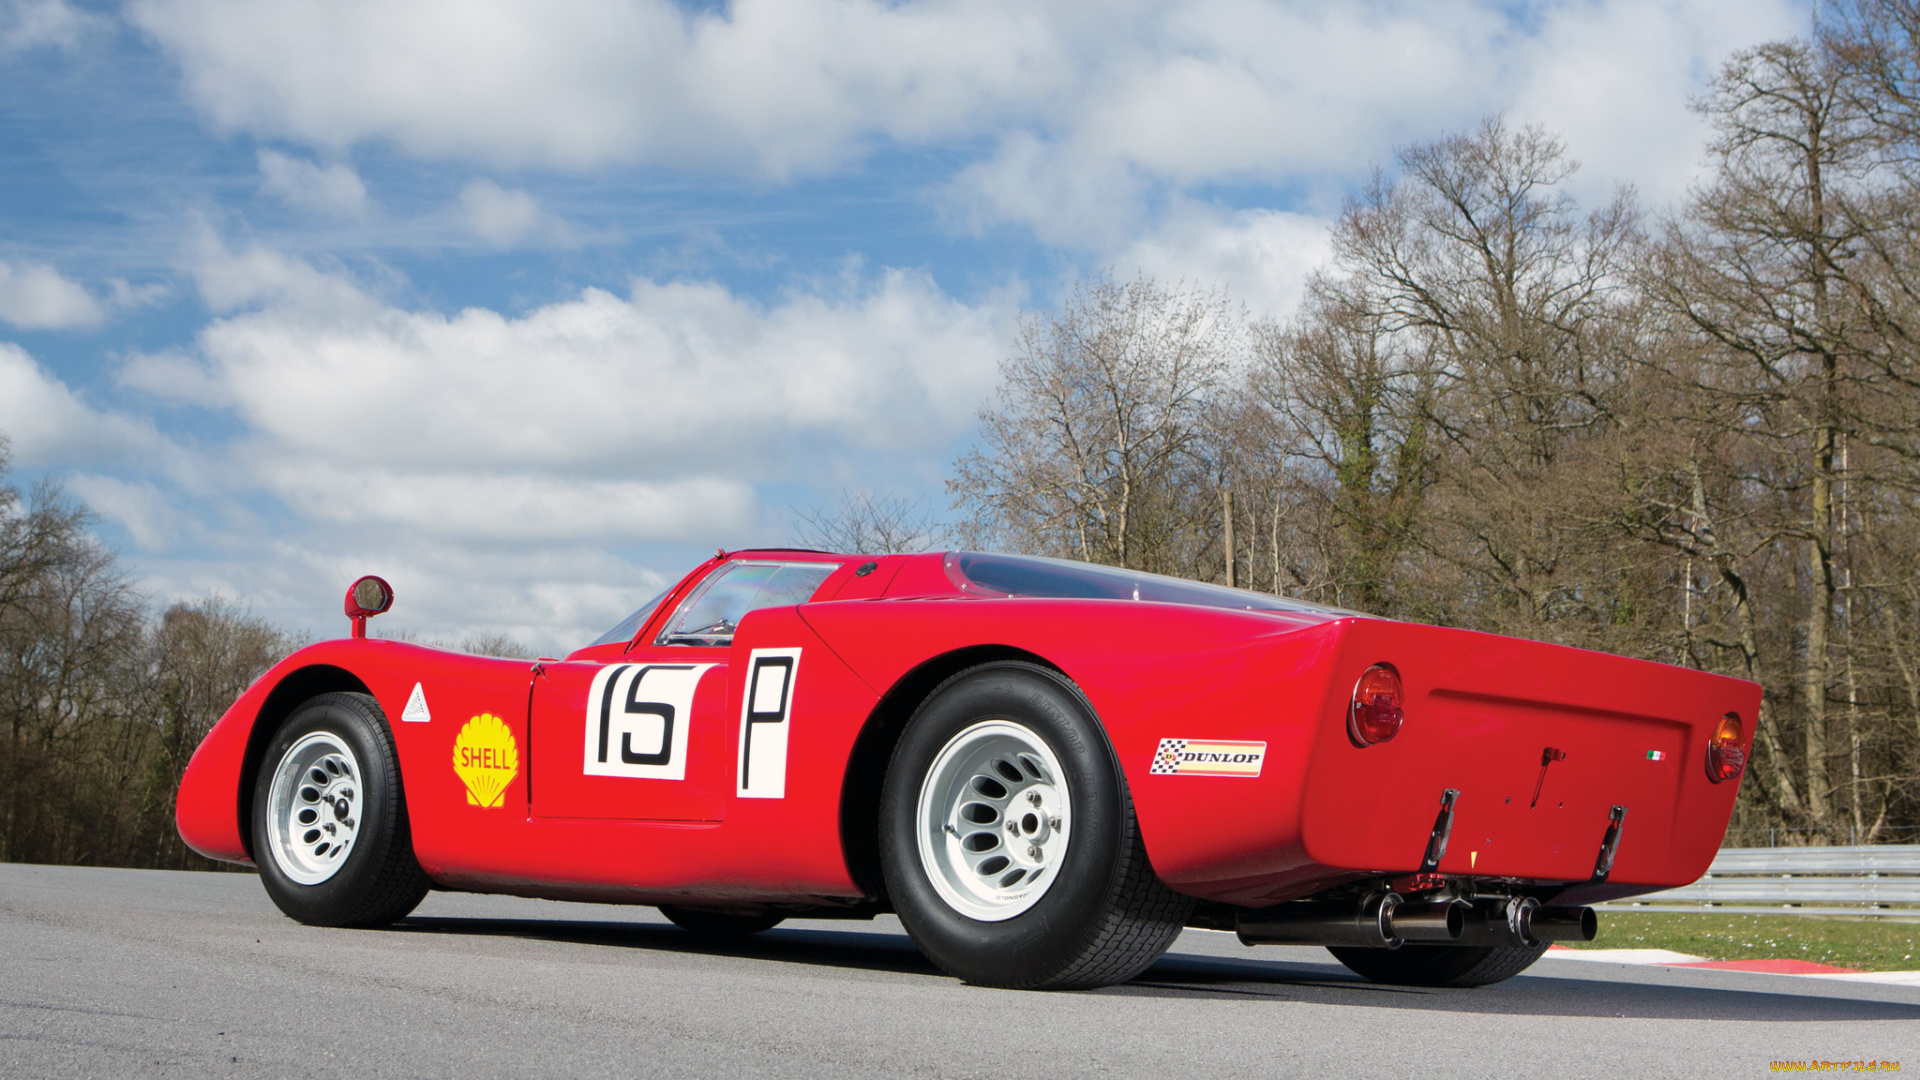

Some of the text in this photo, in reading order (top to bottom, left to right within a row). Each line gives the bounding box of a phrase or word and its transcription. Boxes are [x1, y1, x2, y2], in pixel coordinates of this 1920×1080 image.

[461, 746, 510, 770] SHELL
[598, 665, 698, 766] 15
[742, 656, 793, 790] P
[1182, 752, 1260, 763] DUNLOP
[1030, 693, 1099, 860] DUNLOP RACING
